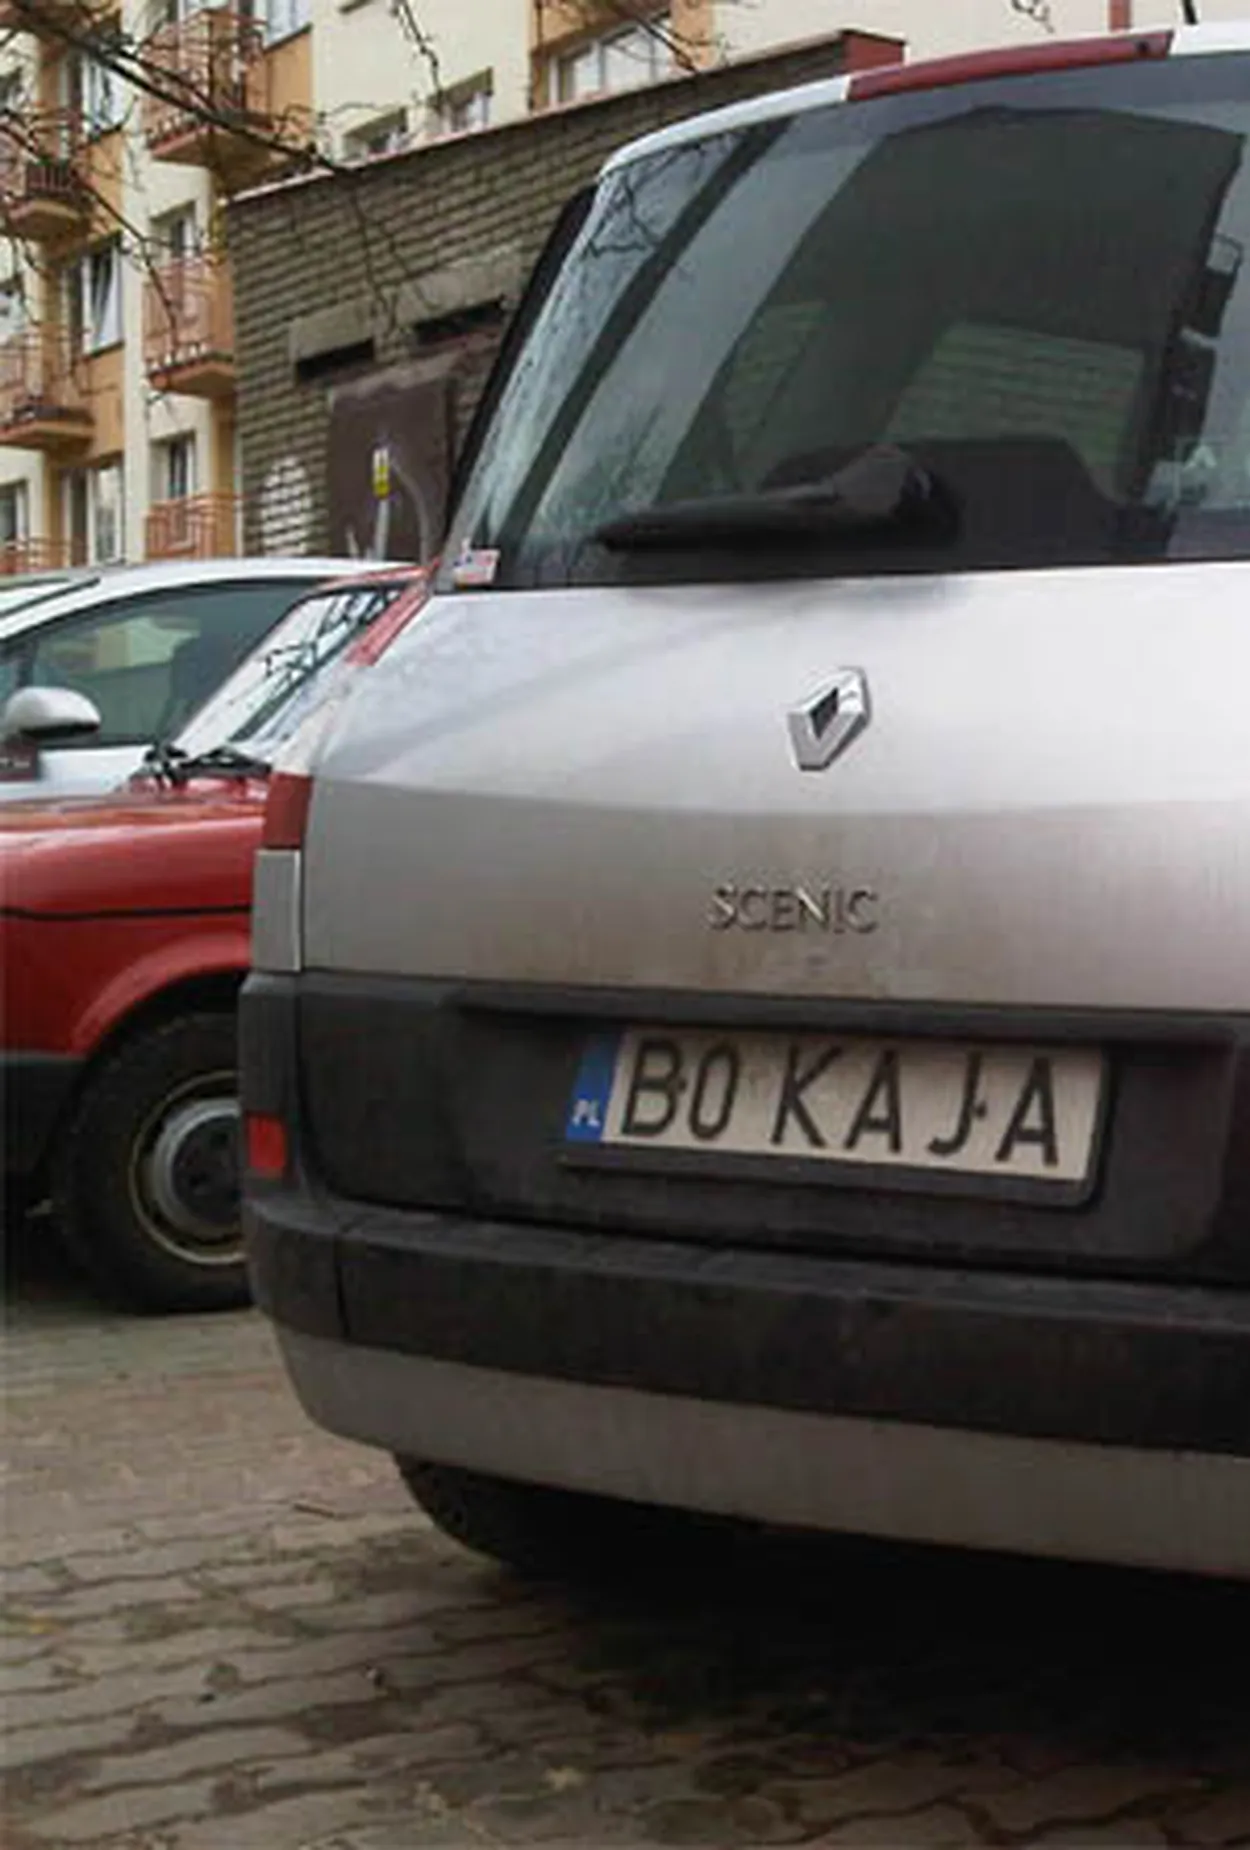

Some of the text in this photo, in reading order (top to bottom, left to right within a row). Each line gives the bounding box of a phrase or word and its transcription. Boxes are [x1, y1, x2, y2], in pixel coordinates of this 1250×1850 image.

[706, 884, 878, 934] SCENIC
[571, 1098, 601, 1127] PL
[770, 1044, 1059, 1167] KAJA
